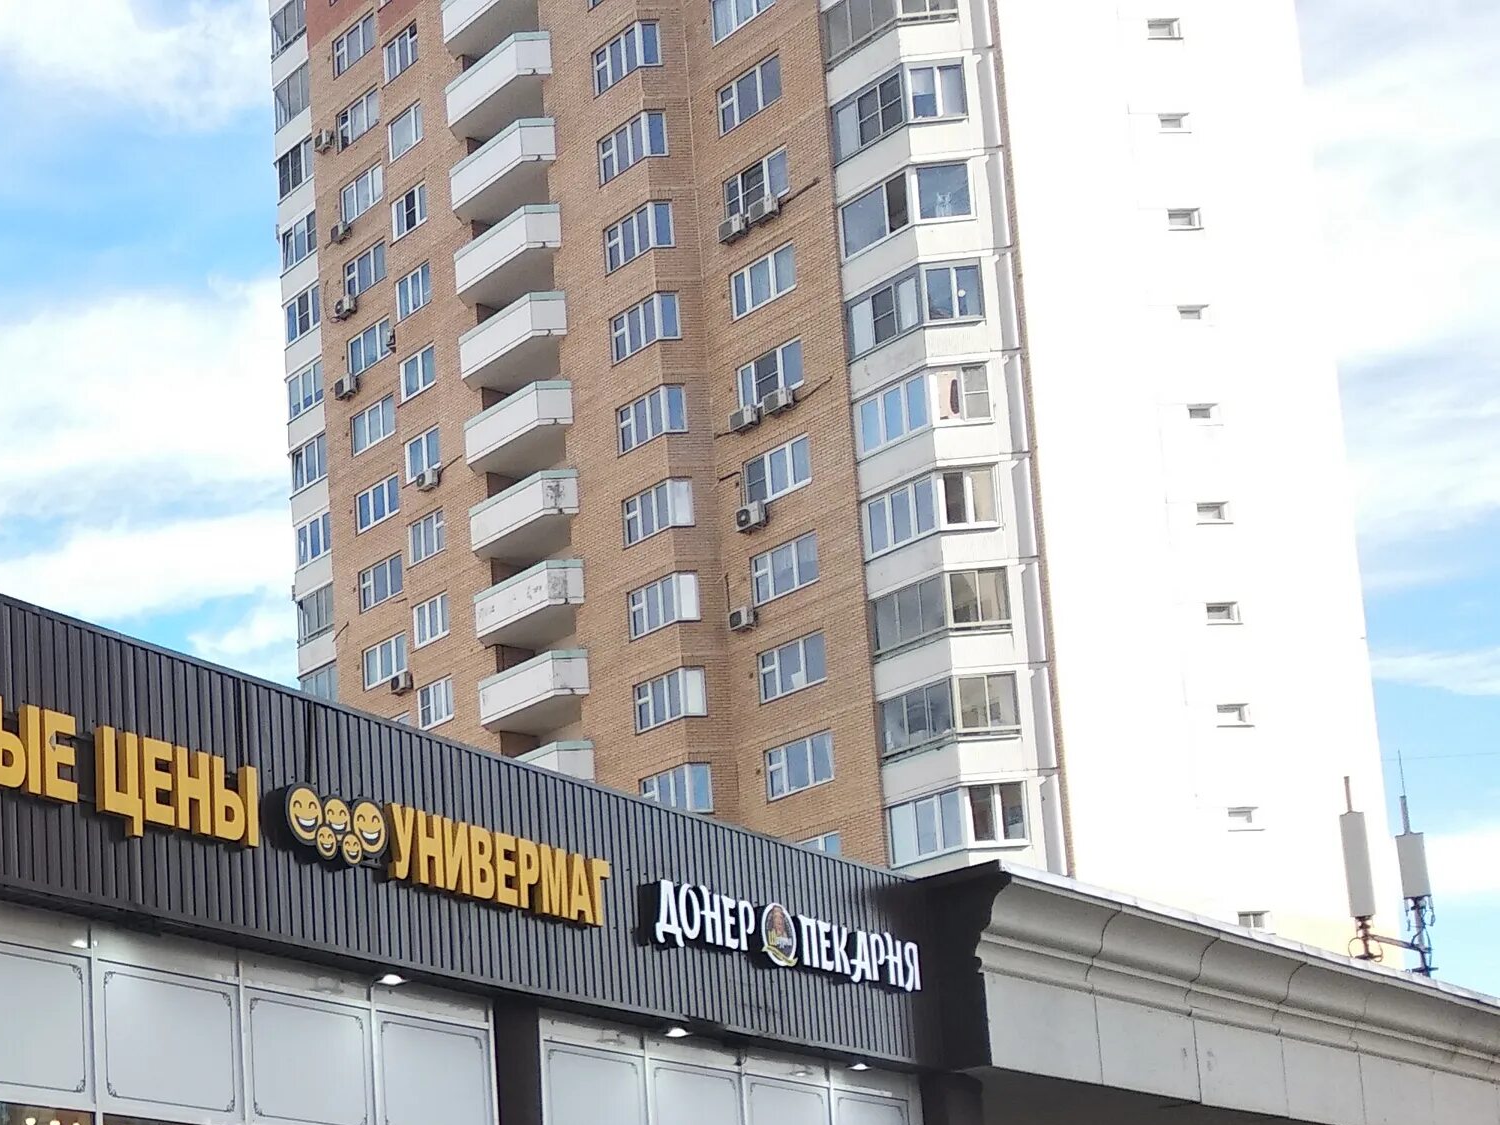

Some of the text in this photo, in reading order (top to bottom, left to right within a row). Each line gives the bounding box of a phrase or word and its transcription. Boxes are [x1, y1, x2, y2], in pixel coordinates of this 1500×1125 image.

[96, 725, 259, 849] ЦЕНЫ
[387, 802, 610, 928] УНИВЕРМАГ
[655, 879, 922, 992] ДОНЕР ПЕКАРНЯ
